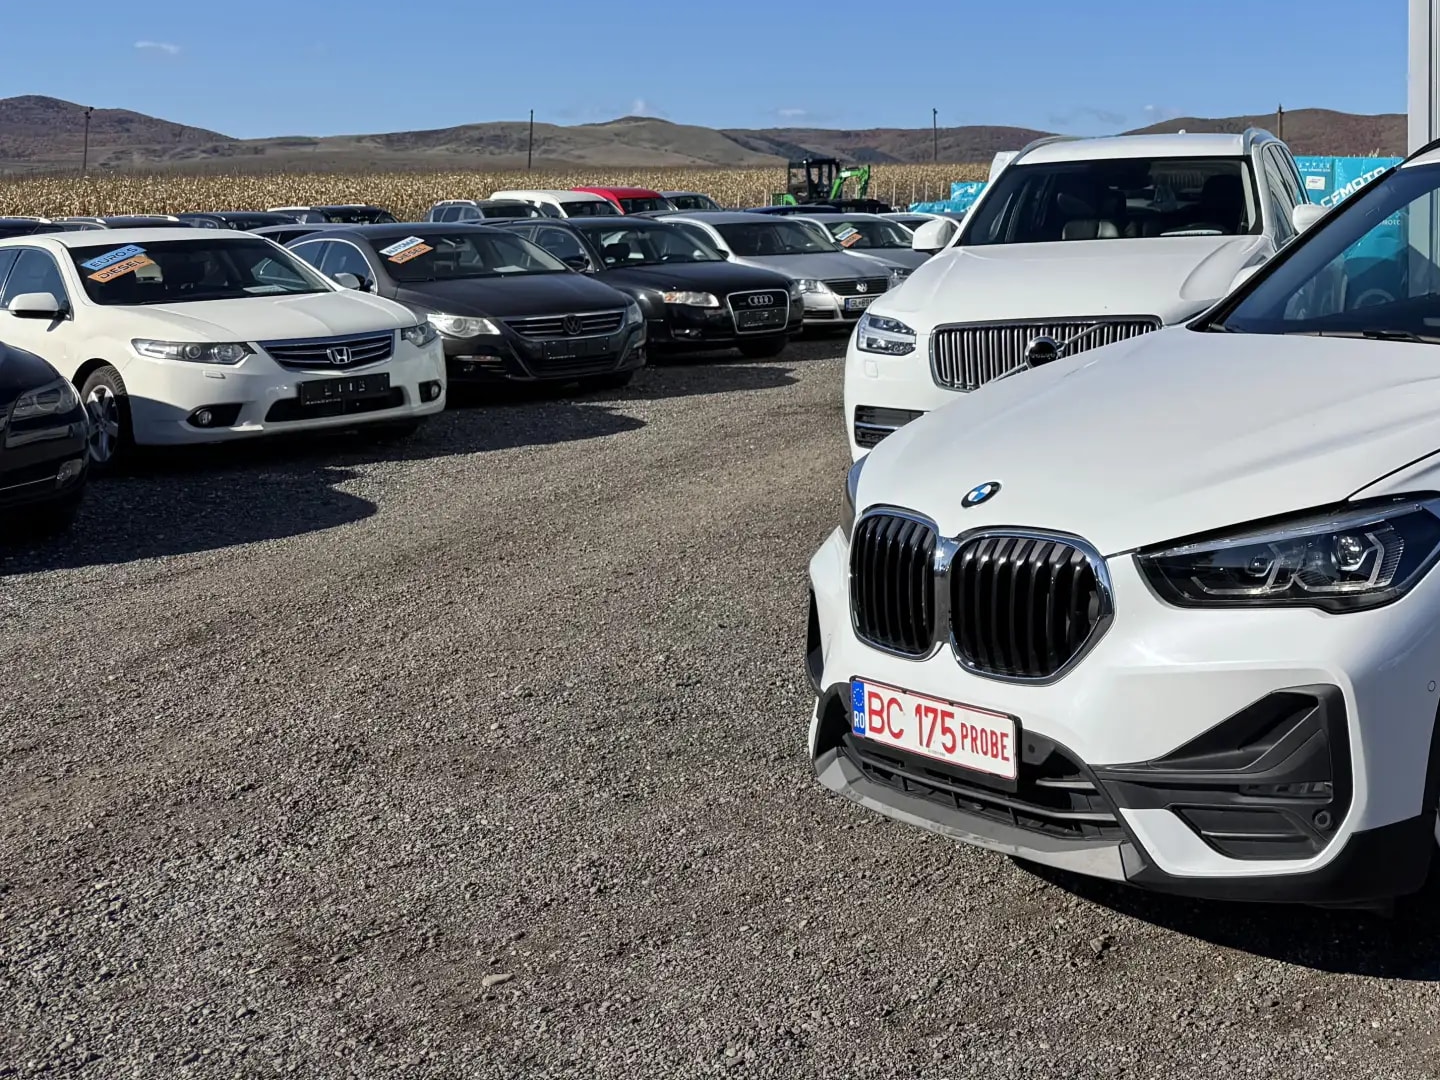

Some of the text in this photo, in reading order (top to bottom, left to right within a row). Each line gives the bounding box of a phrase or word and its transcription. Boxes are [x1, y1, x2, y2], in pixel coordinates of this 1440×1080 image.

[1320, 166, 1386, 207] CFMOTO
[90, 251, 127, 268] EURO
[98, 260, 145, 279] DIESEL
[853, 710, 865, 729] RO
[867, 690, 1010, 762] BC 175 PROBE
